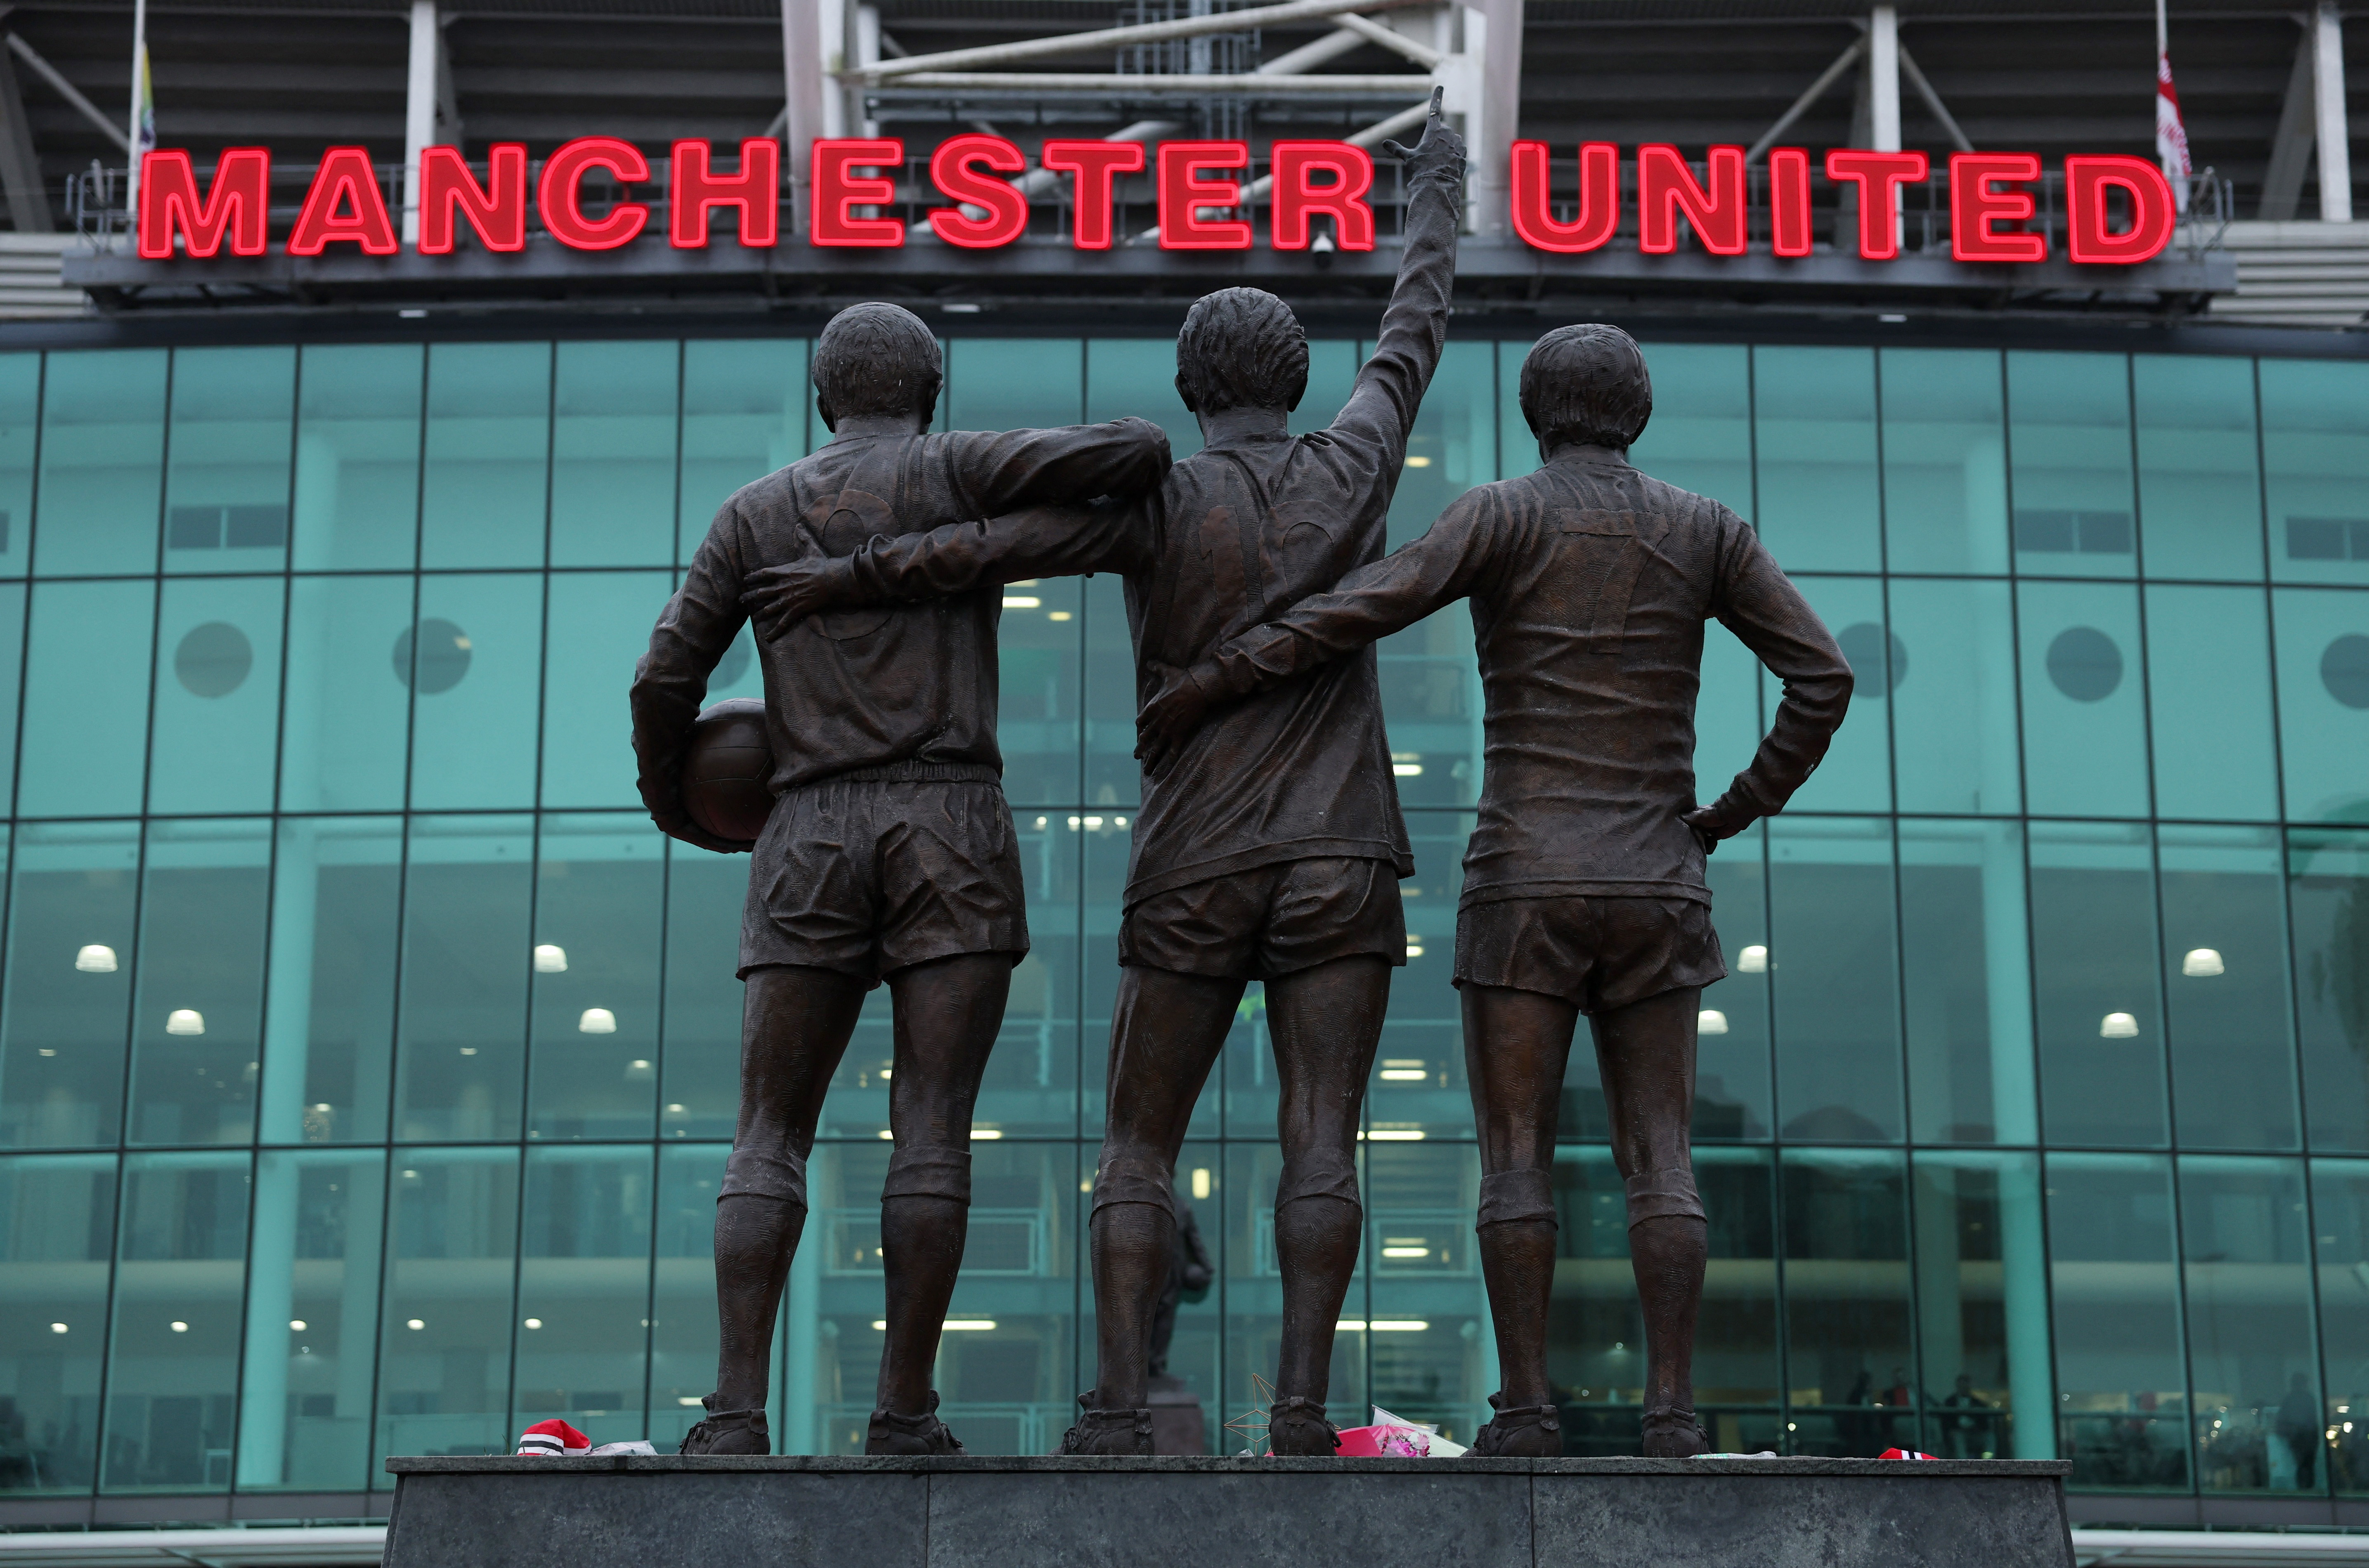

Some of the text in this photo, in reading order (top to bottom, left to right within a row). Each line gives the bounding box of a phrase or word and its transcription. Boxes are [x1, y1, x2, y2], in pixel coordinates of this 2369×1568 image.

[138, 135, 1374, 258] MANCHESTER
[1511, 140, 2175, 263] UNITED
[1559, 508, 1669, 655] 7
